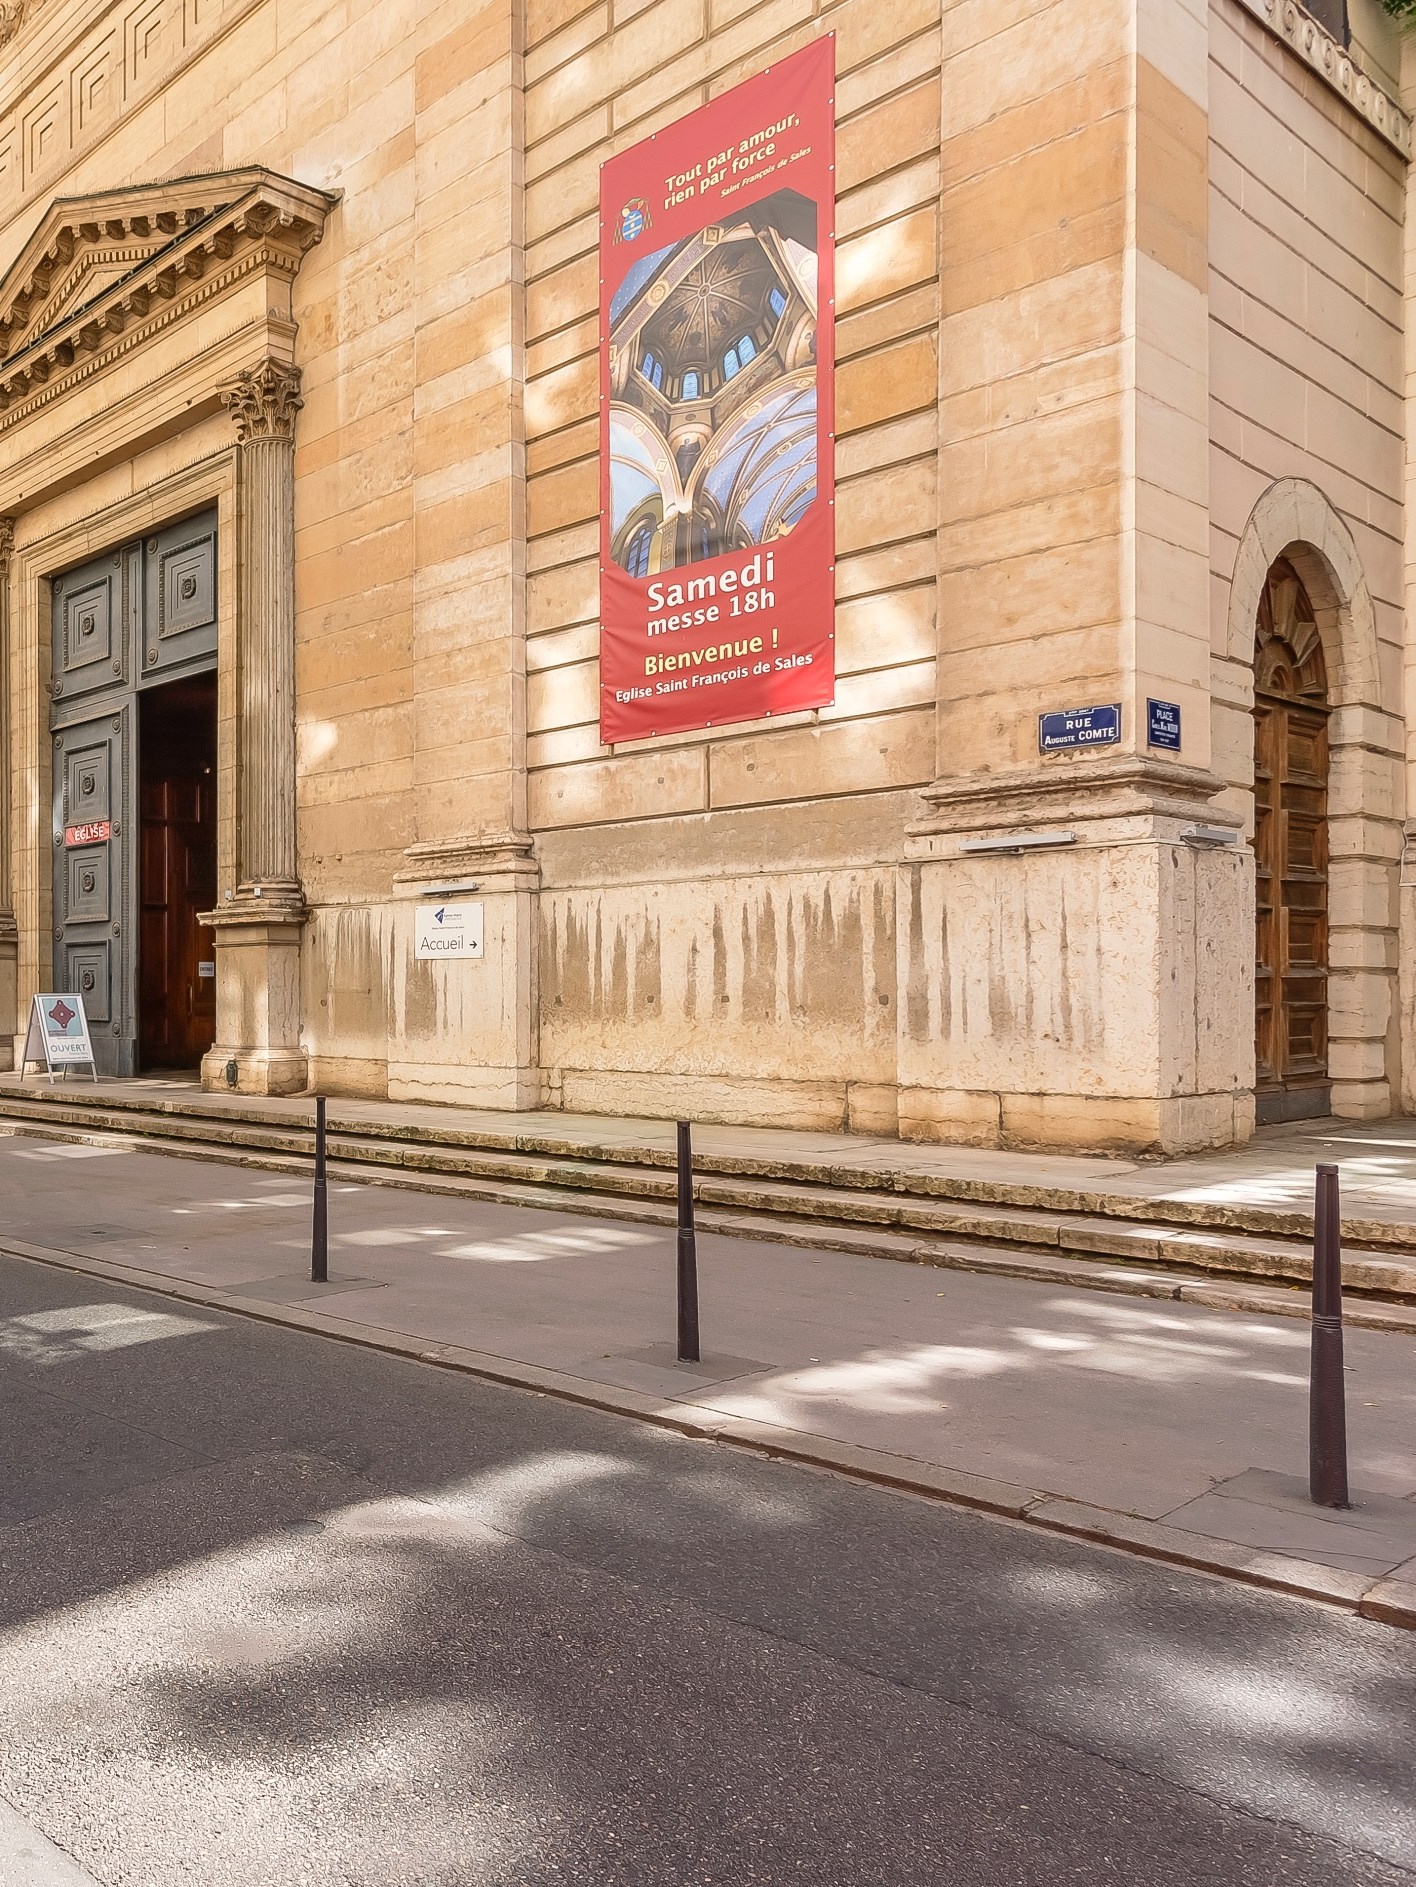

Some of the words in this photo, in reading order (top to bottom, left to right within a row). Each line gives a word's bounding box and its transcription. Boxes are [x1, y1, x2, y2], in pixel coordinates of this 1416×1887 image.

[664, 164, 702, 192] Tout
[707, 147, 734, 174] par
[739, 113, 800, 154] amour,
[720, 182, 740, 198] Saint
[741, 164, 775, 188] François
[777, 158, 788, 169] de
[789, 146, 812, 164] Sales
[664, 189, 695, 210] rien
[700, 169, 727, 194] par
[731, 143, 776, 173] force
[647, 551, 775, 612] Samedi
[647, 604, 720, 637] messe
[729, 587, 775, 617] 18h
[644, 636, 763, 676] Bienvenue
[616, 687, 653, 704] Eglise
[656, 679, 688, 695] Saint
[691, 666, 749, 686] François
[752, 661, 771, 675] de
[774, 654, 813, 672] Sales
[1066, 718, 1092, 730] RUE
[1078, 727, 1115, 740] COMTE
[1156, 709, 1174, 722] PLACE
[420, 934, 464, 951] Accueil
[50, 1043, 86, 1053] OUVERT
